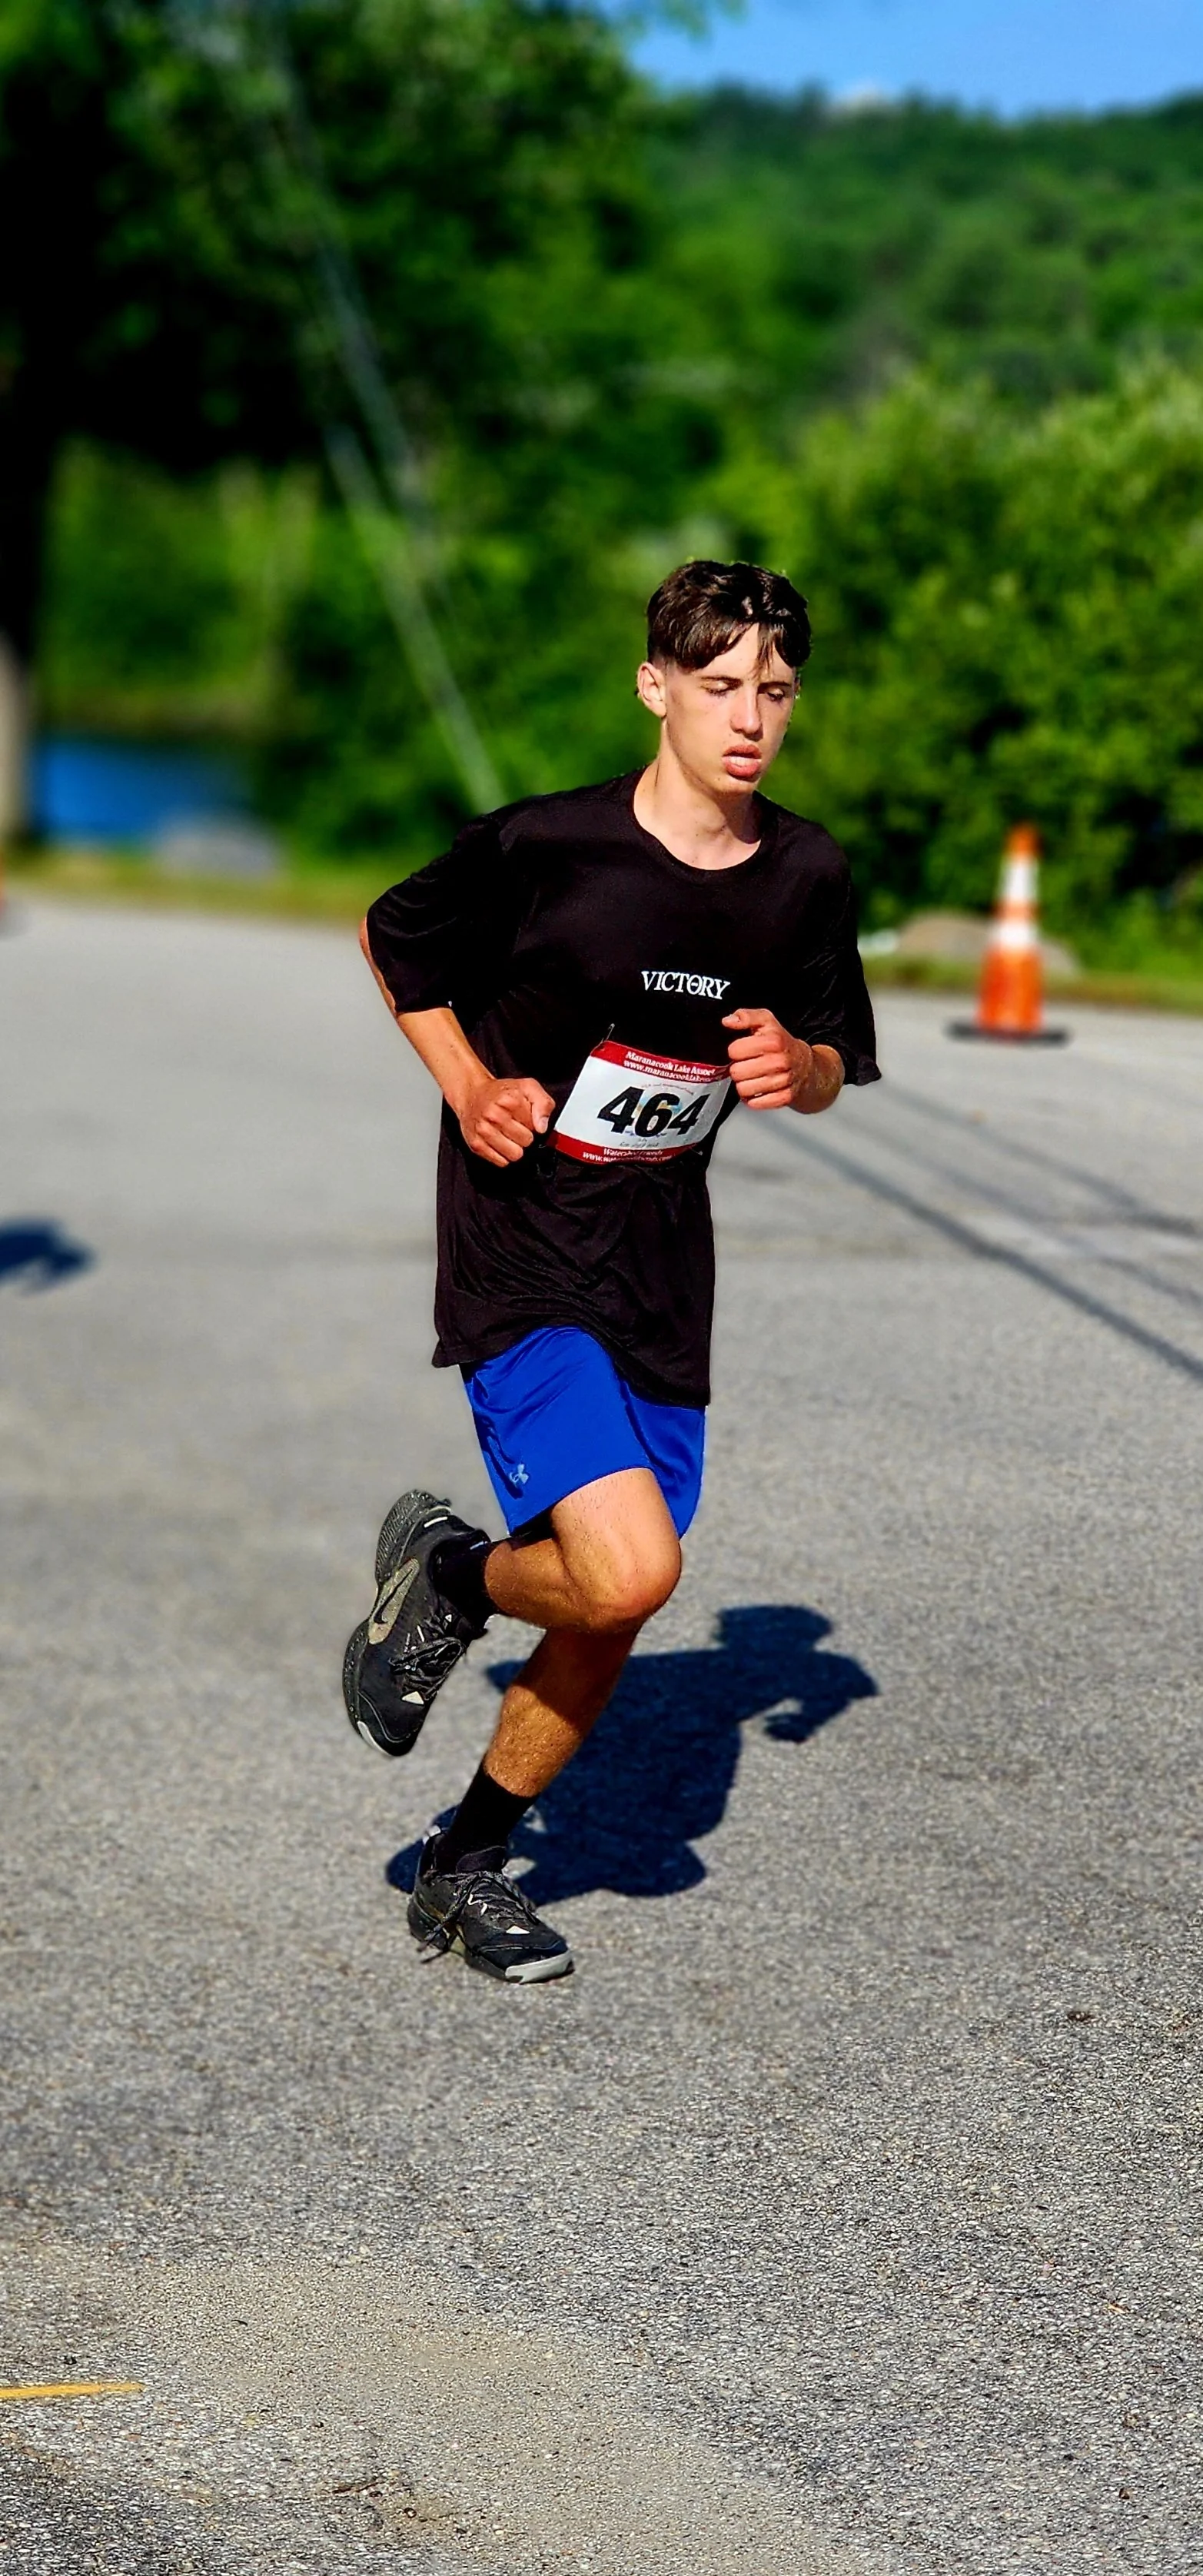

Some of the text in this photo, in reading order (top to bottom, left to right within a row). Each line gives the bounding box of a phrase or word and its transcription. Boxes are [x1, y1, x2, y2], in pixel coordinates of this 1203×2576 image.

[641, 970, 731, 1000] VICTORY
[625, 1050, 674, 1071] Maranacook
[673, 1063, 691, 1074] Lake
[597, 1085, 711, 1137] 464
